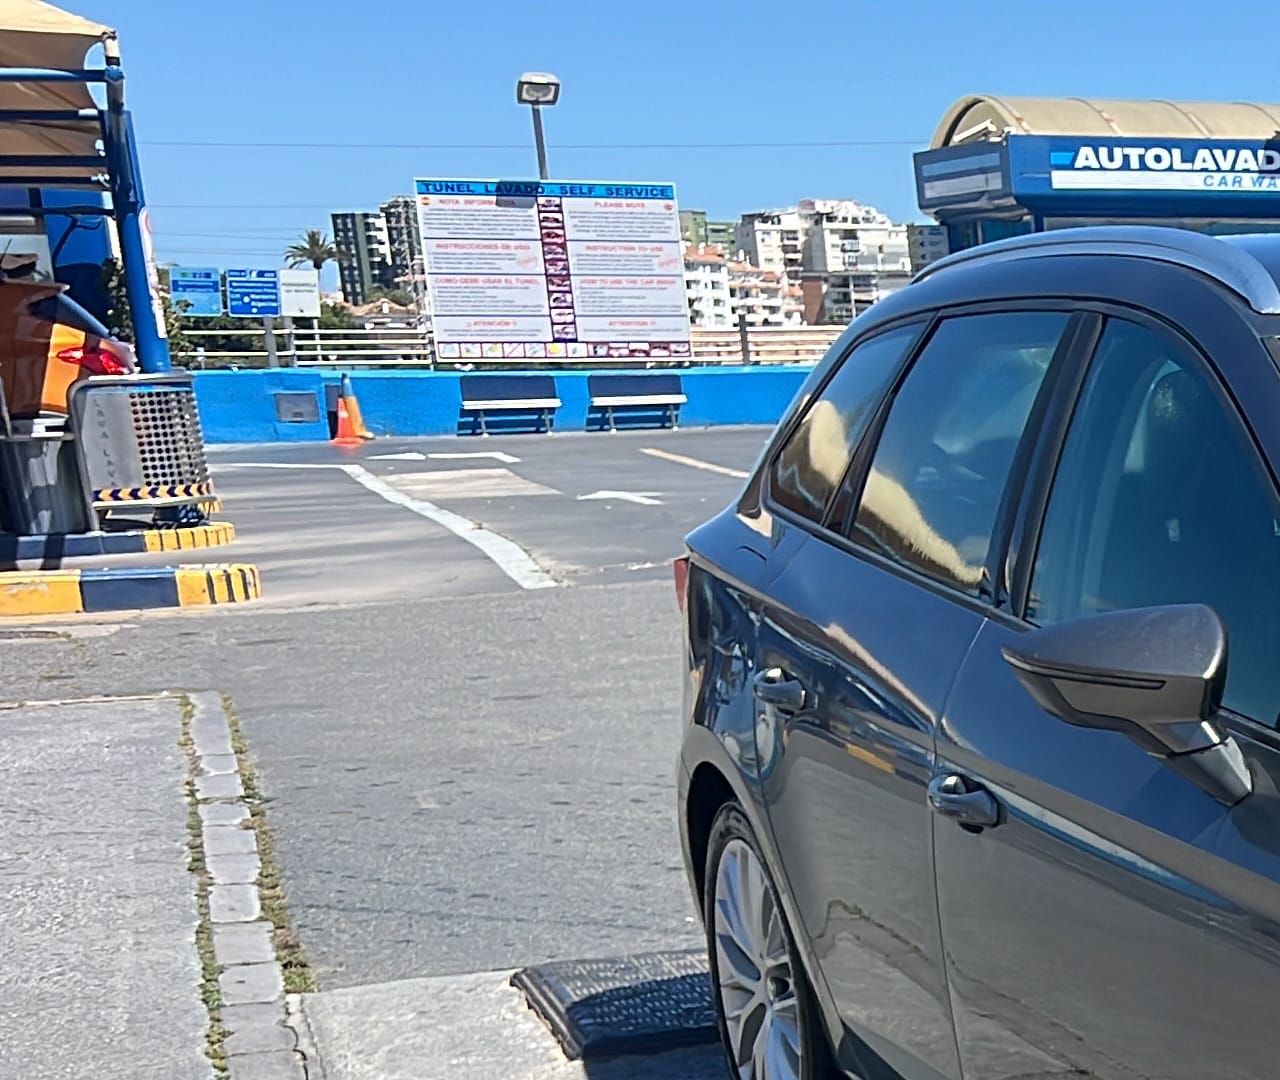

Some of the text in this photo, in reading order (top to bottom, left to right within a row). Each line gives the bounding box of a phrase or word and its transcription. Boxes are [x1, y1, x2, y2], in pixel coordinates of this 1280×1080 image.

[1203, 175, 1243, 188] CAR
[422, 182, 474, 193] TUNEL
[484, 183, 545, 194] LAVADO
[560, 185, 596, 195] SELF
[605, 186, 670, 197] SERVICE
